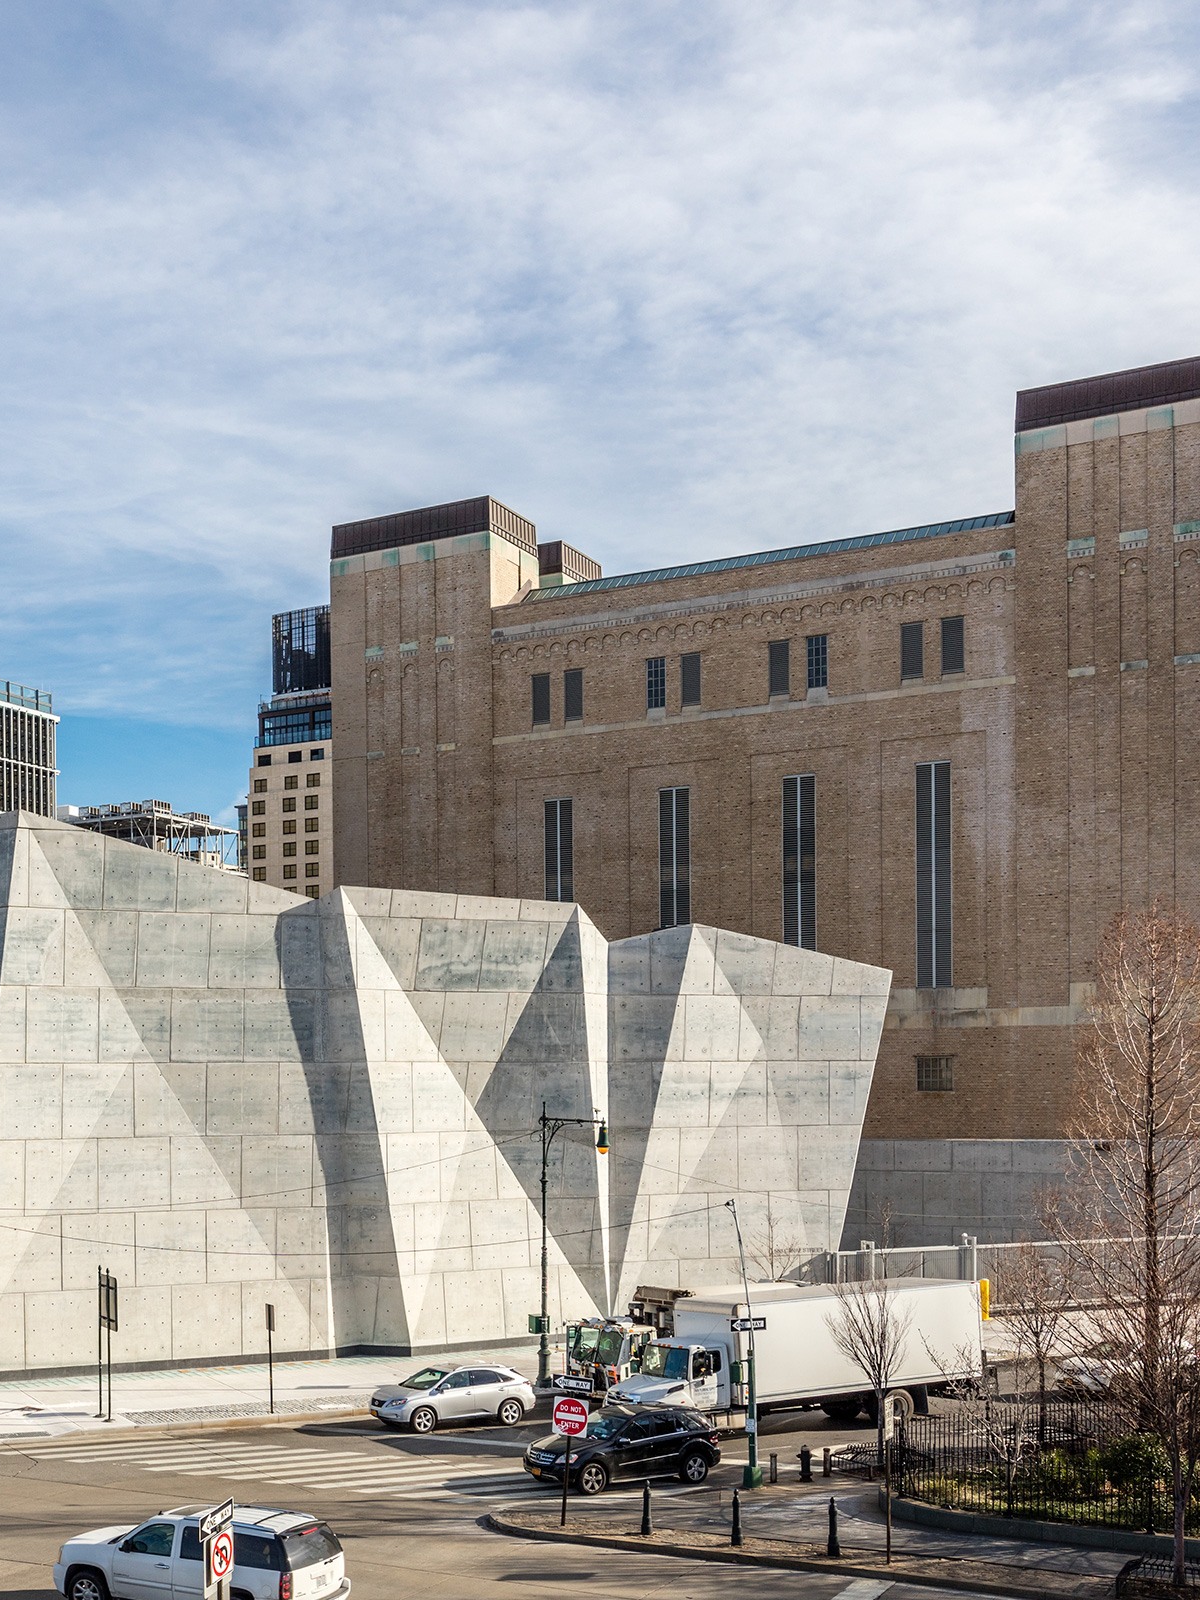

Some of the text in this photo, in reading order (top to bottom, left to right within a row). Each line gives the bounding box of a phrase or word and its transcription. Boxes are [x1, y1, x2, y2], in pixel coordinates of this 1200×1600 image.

[575, 1381, 588, 1389] WAY
[560, 1420, 580, 1429] ENTER
[206, 1508, 230, 1530] ONE WAY
